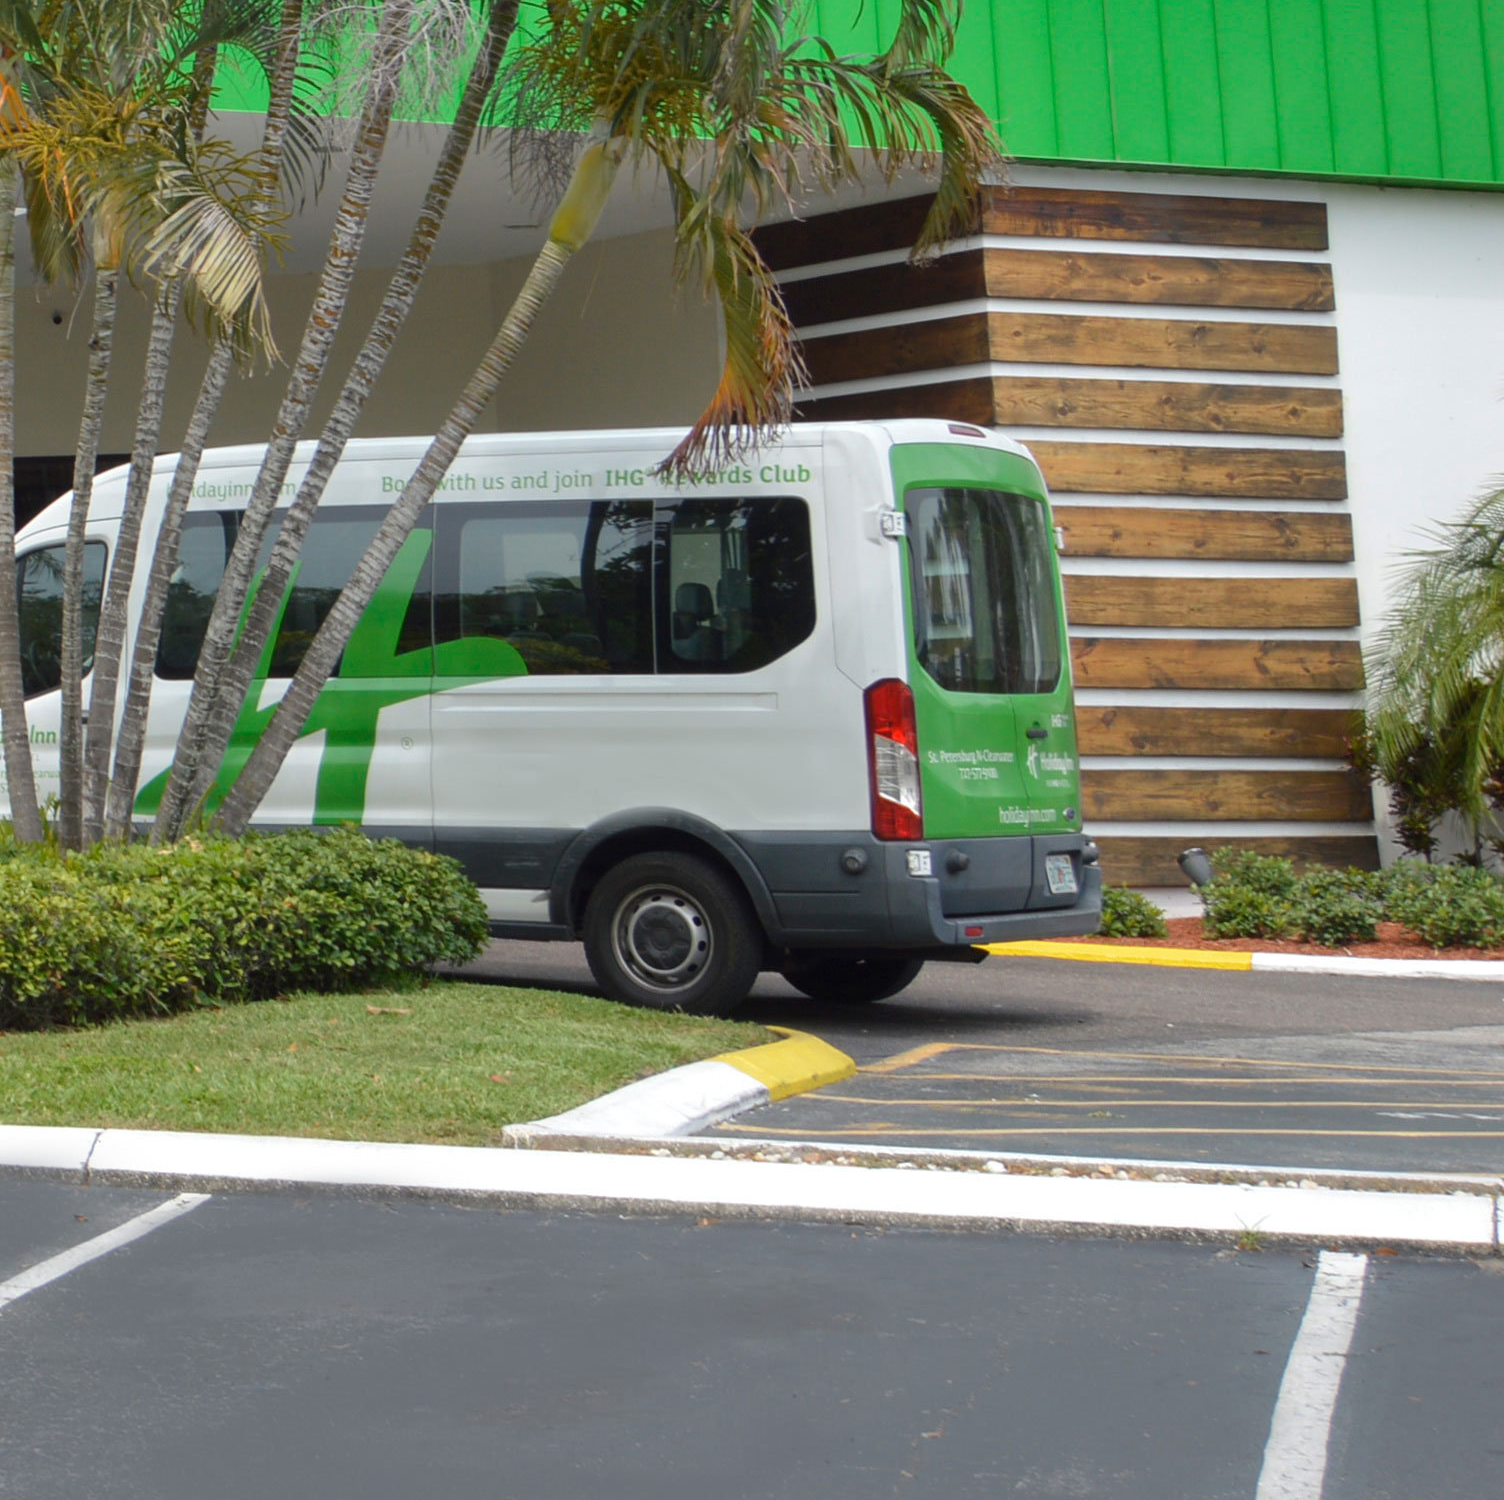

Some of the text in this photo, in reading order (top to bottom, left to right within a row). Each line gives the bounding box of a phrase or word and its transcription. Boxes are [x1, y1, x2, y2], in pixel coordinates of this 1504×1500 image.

[482, 476, 505, 490] us
[511, 471, 548, 490] and
[553, 470, 593, 493] join
[760, 463, 811, 483] Club
[29, 724, 57, 744] Inn
